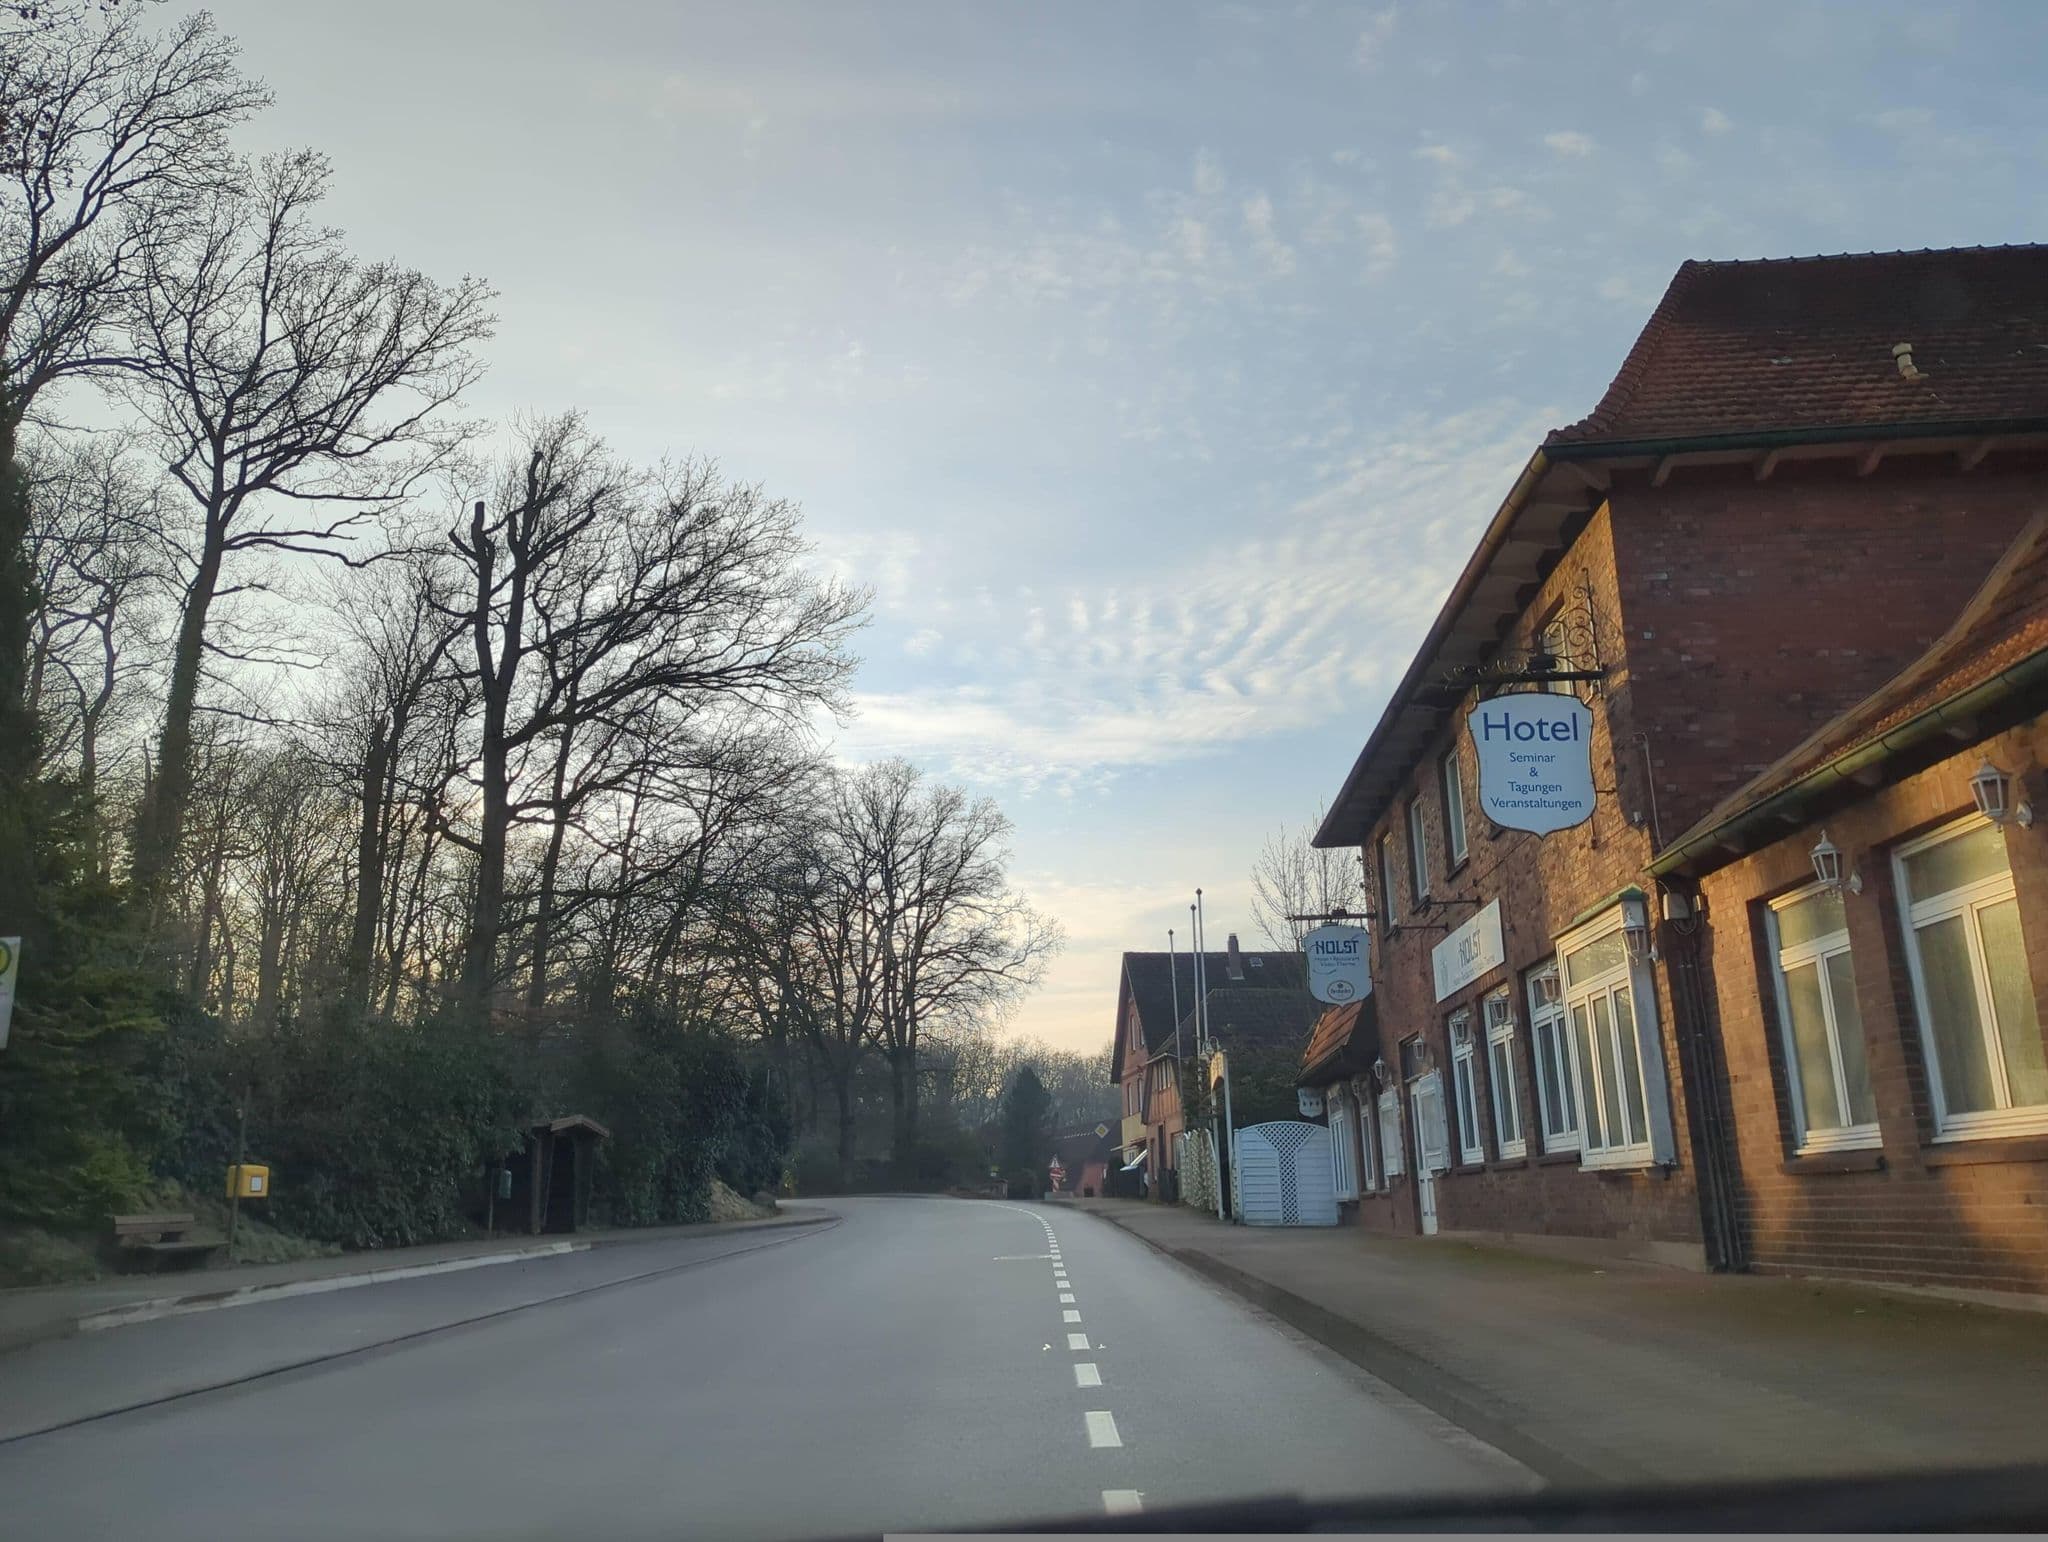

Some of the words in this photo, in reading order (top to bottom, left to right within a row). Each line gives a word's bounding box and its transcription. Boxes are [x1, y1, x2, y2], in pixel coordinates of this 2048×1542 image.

[1483, 712, 1578, 741] Hotel
[1509, 752, 1556, 763] Seminar
[1529, 766, 1539, 777] &
[1507, 781, 1562, 795] Tagungen
[1490, 797, 1582, 811] Veranstaltungen
[1315, 940, 1360, 955] HOLST
[1458, 929, 1481, 968] HOLST
